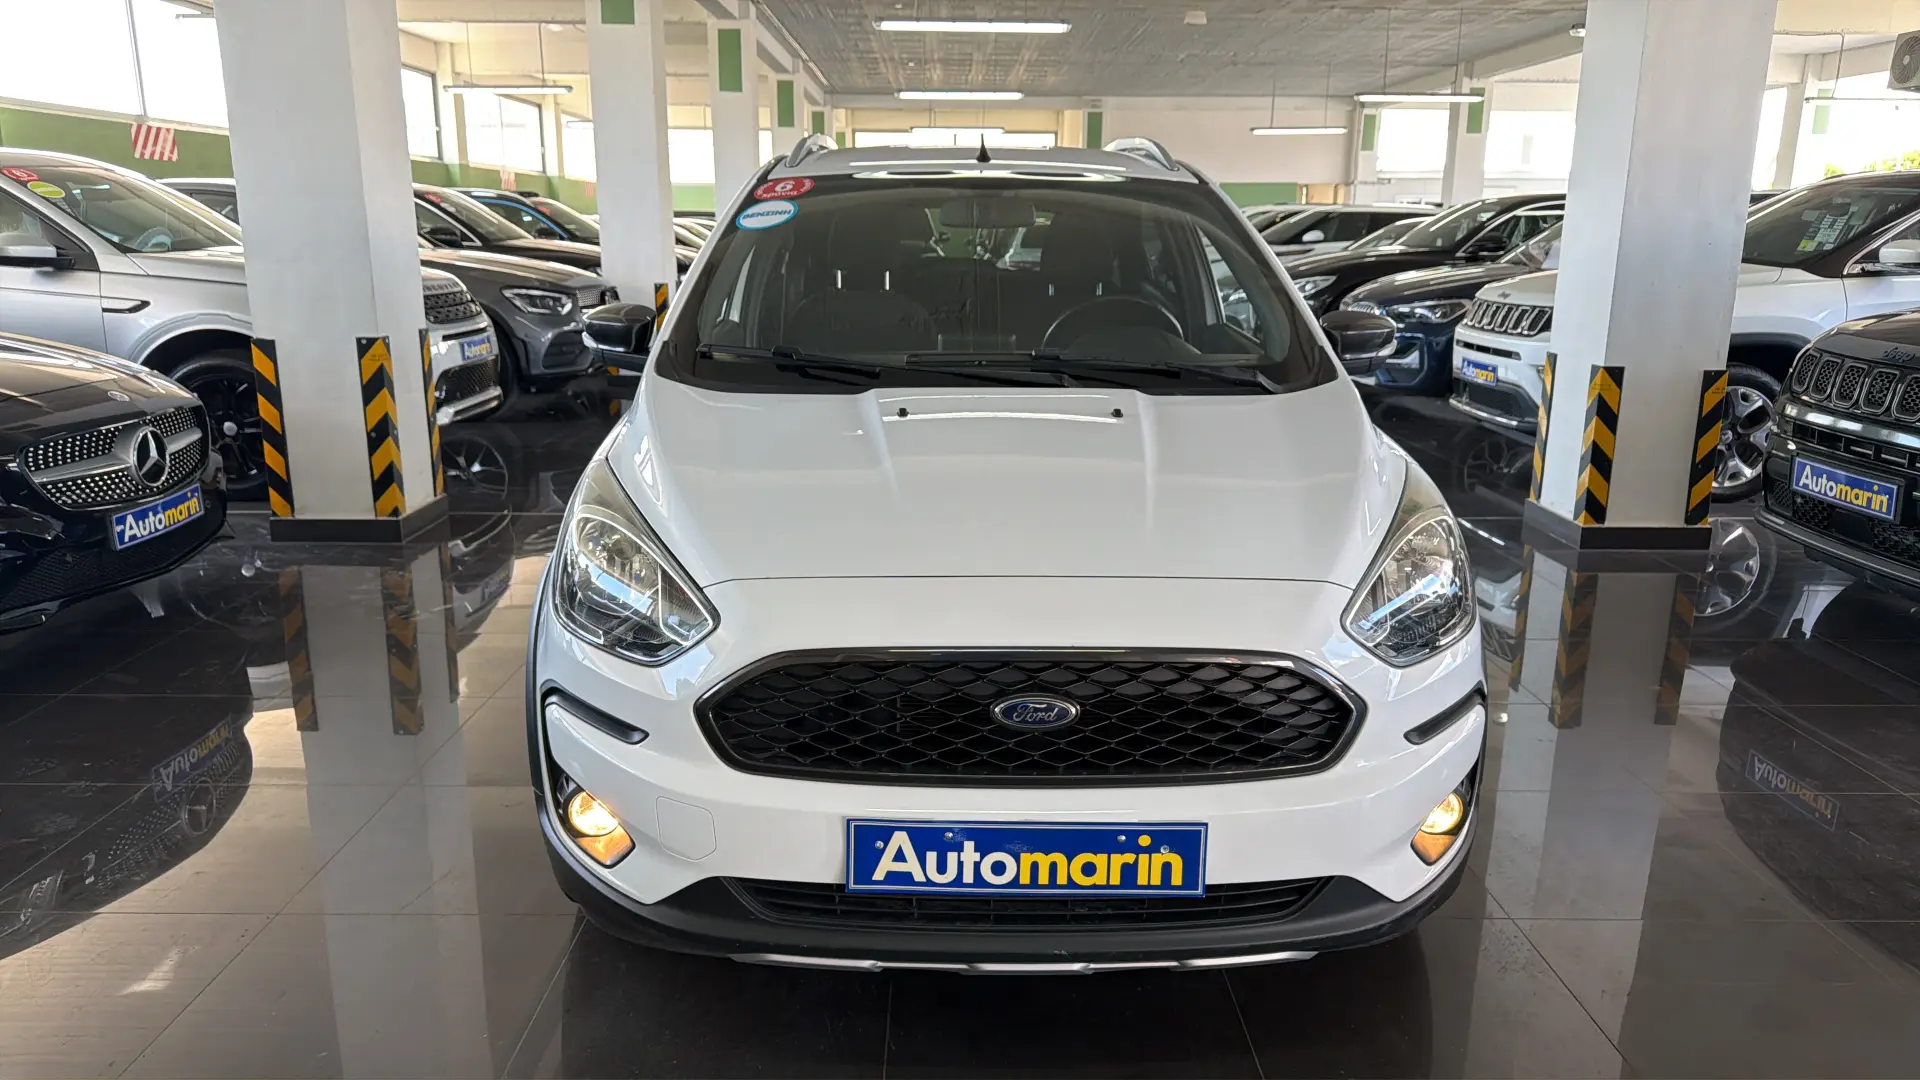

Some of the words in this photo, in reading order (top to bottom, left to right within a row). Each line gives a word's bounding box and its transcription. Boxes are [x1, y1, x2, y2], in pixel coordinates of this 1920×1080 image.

[775, 181, 796, 192] 6
[1799, 465, 1889, 513] Automarin
[124, 491, 200, 542] Automarin
[1012, 703, 1060, 722] Ford
[871, 830, 1184, 887] Automarin
